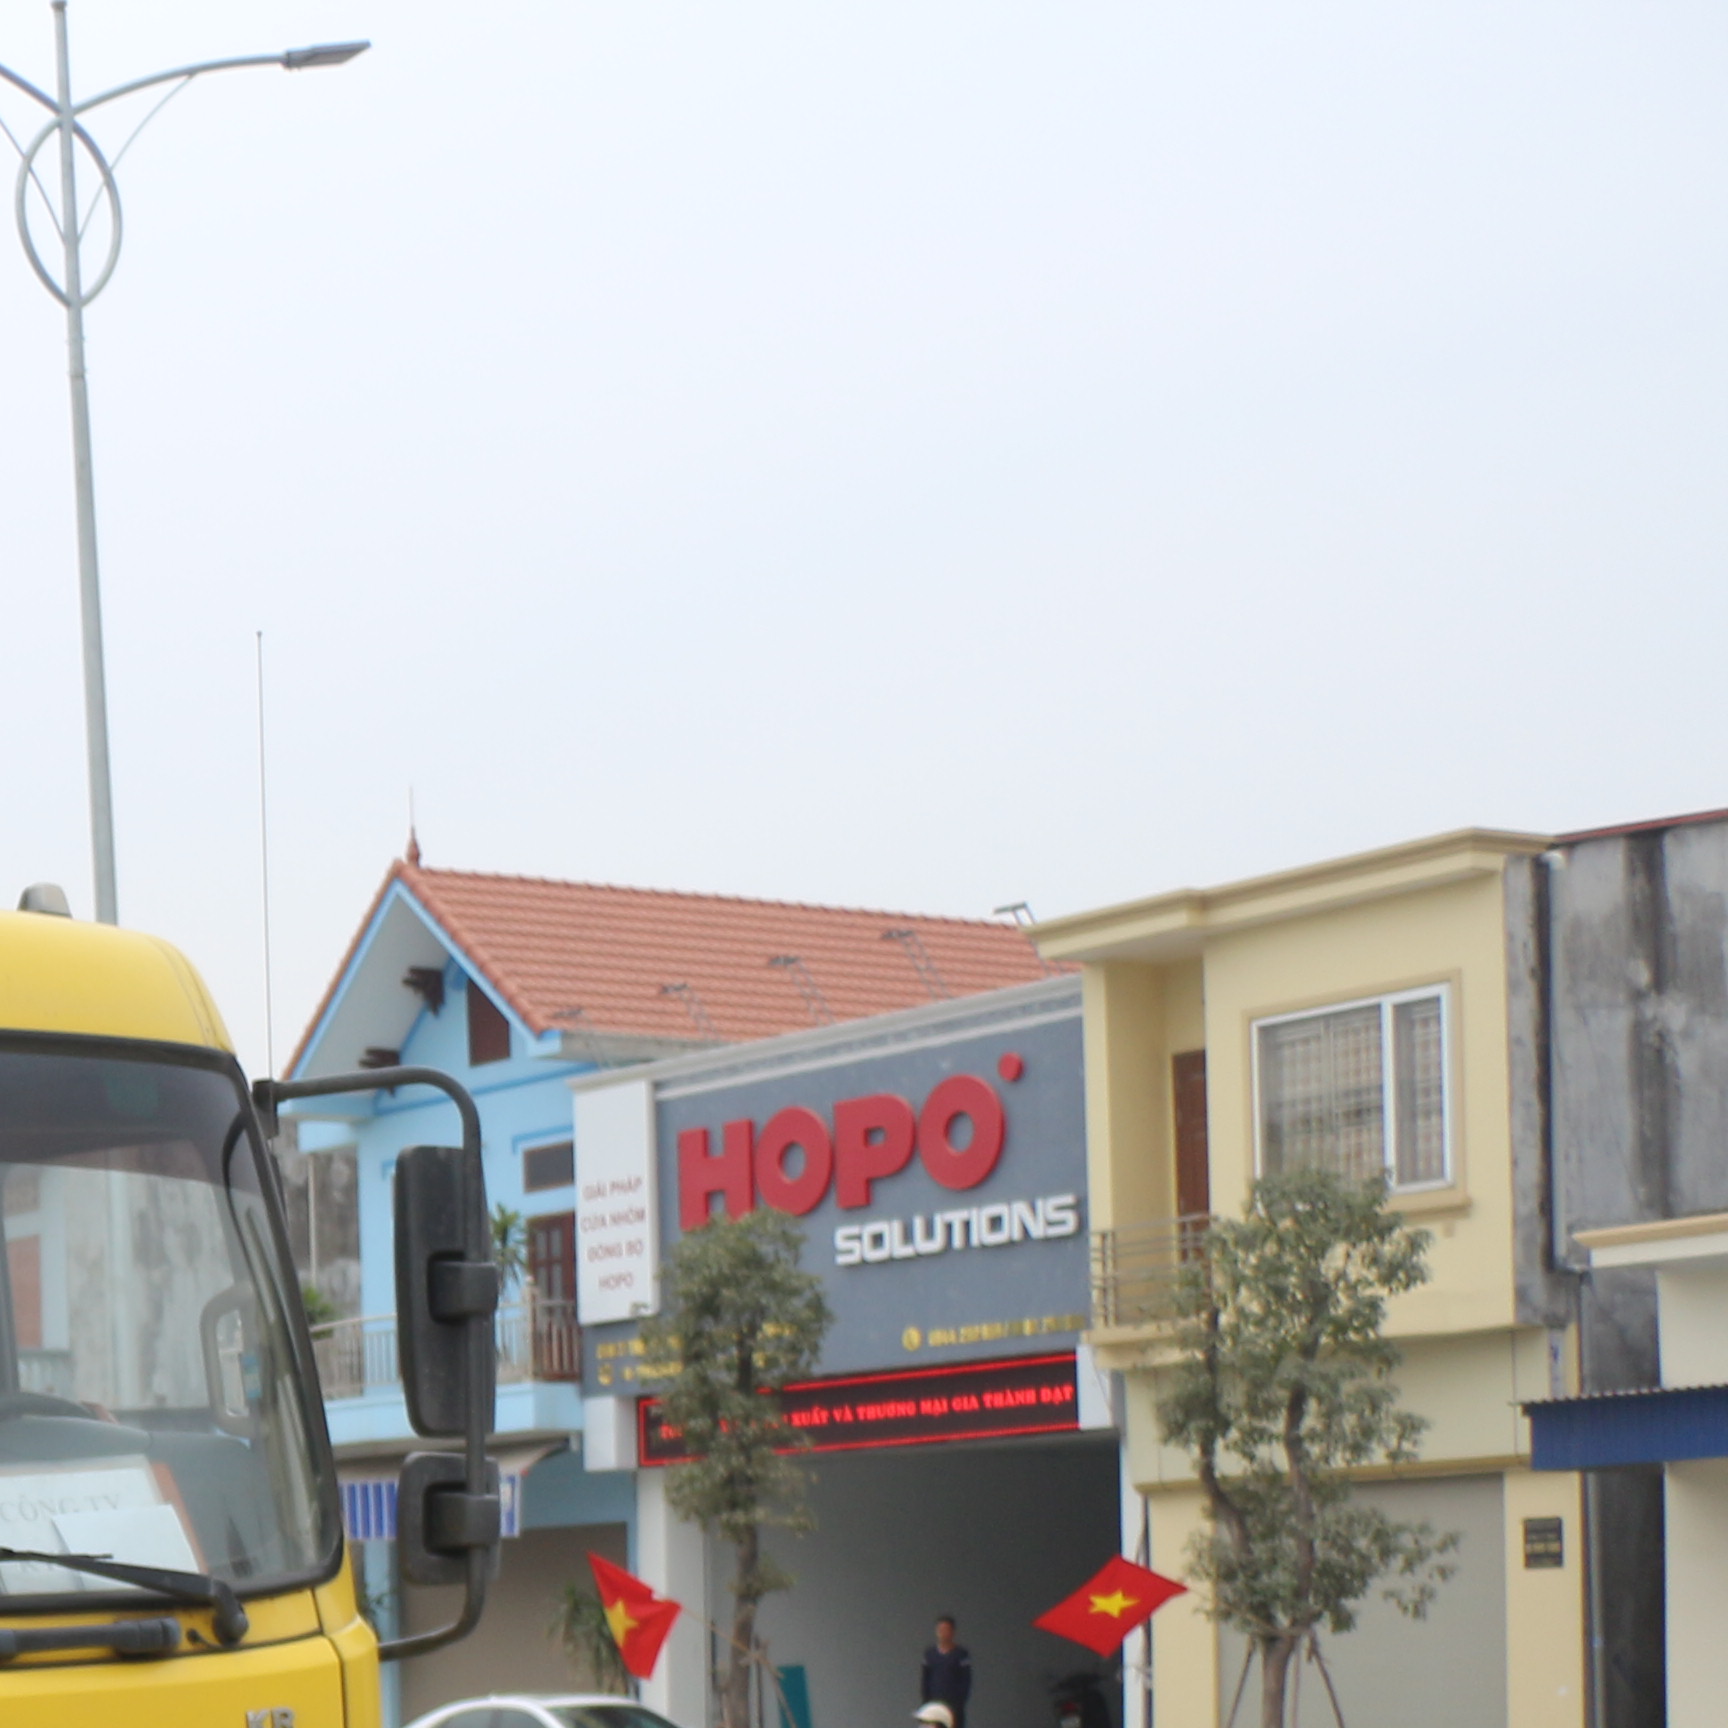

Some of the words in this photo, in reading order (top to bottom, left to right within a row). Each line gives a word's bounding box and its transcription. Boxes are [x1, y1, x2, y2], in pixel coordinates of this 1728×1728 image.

[678, 1074, 1006, 1232] HOPO
[834, 1192, 1079, 1266] SOLUTIONS
[832, 1404, 854, 1422] VÀ
[919, 1398, 949, 1418] MẠI
[951, 1395, 981, 1412] GIA
[982, 1387, 1037, 1409] THÀNH
